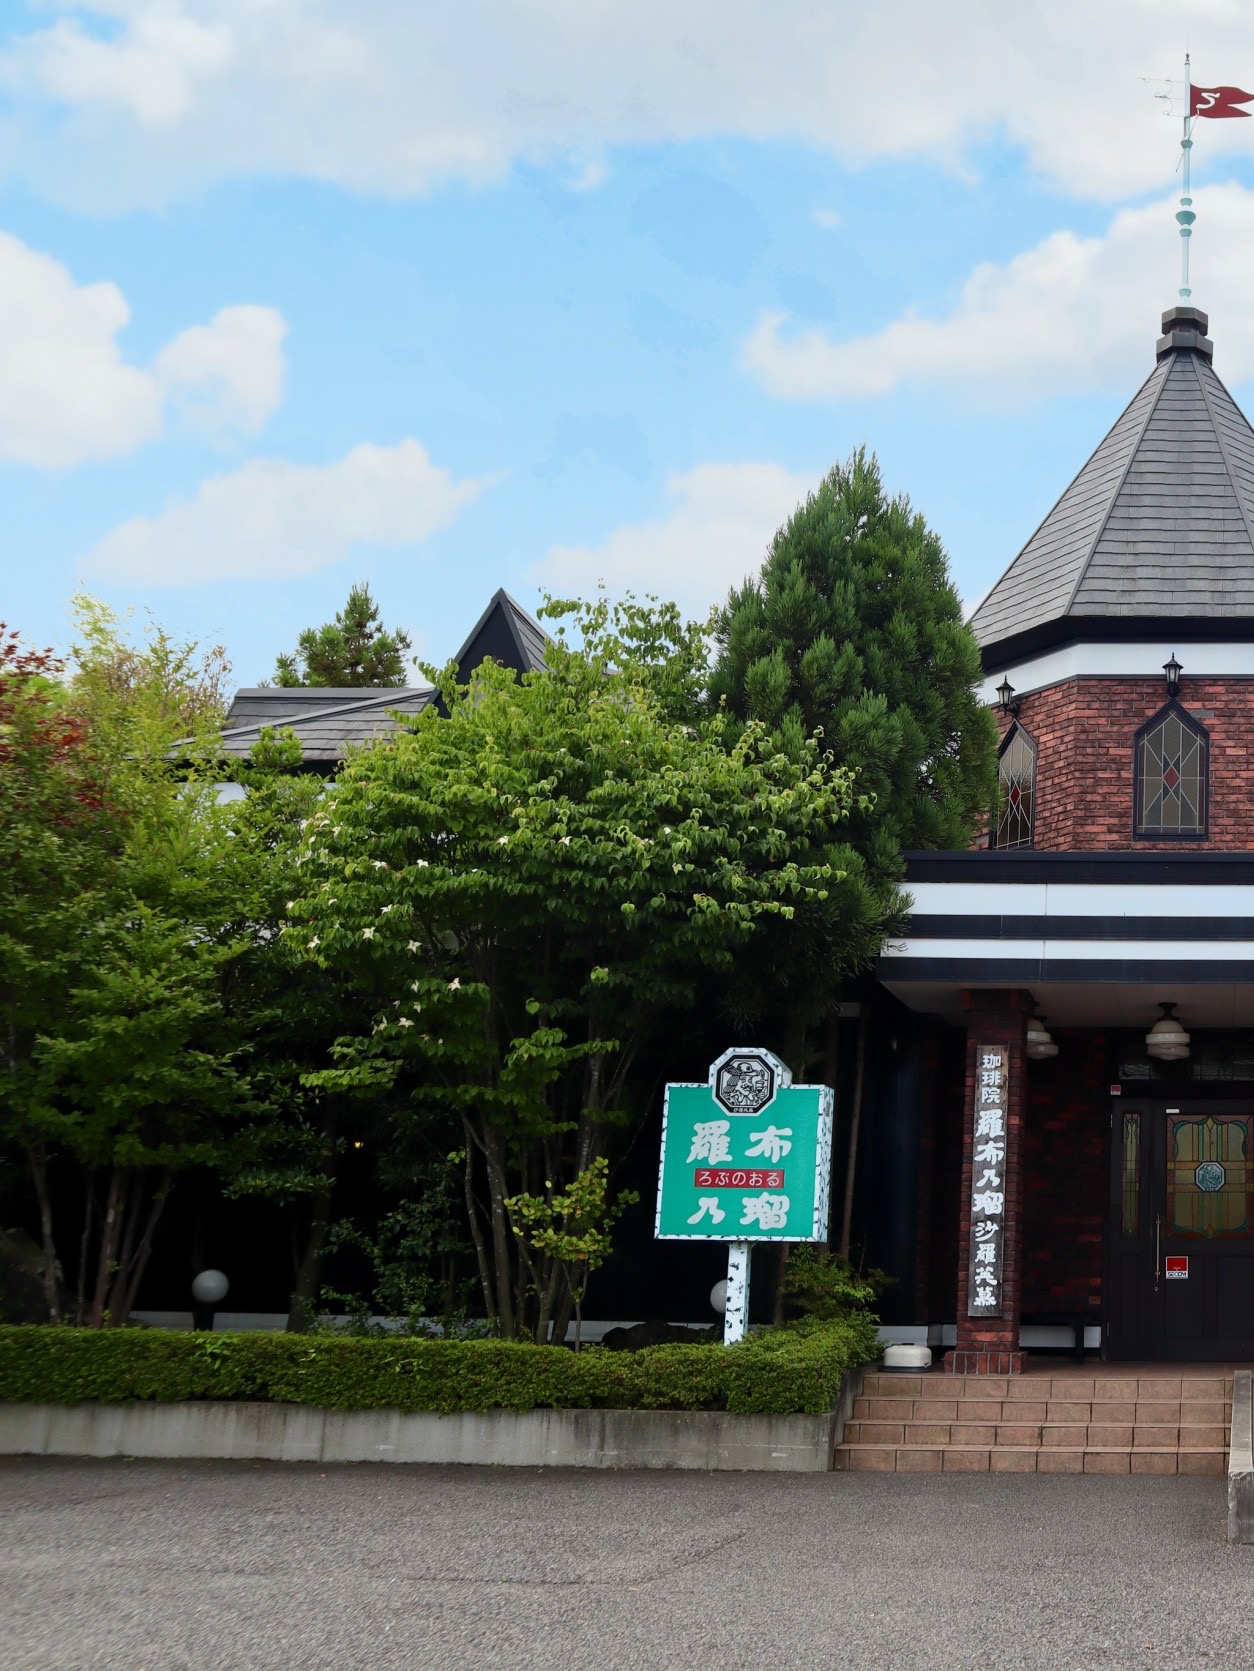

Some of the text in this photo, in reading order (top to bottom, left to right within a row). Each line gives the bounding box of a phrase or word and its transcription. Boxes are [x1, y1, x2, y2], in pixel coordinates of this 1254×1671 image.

[981, 1053, 1001, 1104] 珈琲院
[686, 1120, 793, 1165] 羅布
[972, 1109, 1005, 1215] 羅布乃瑠
[698, 1170, 781, 1187] ろぶのおる
[687, 1192, 790, 1230] 乃瑠
